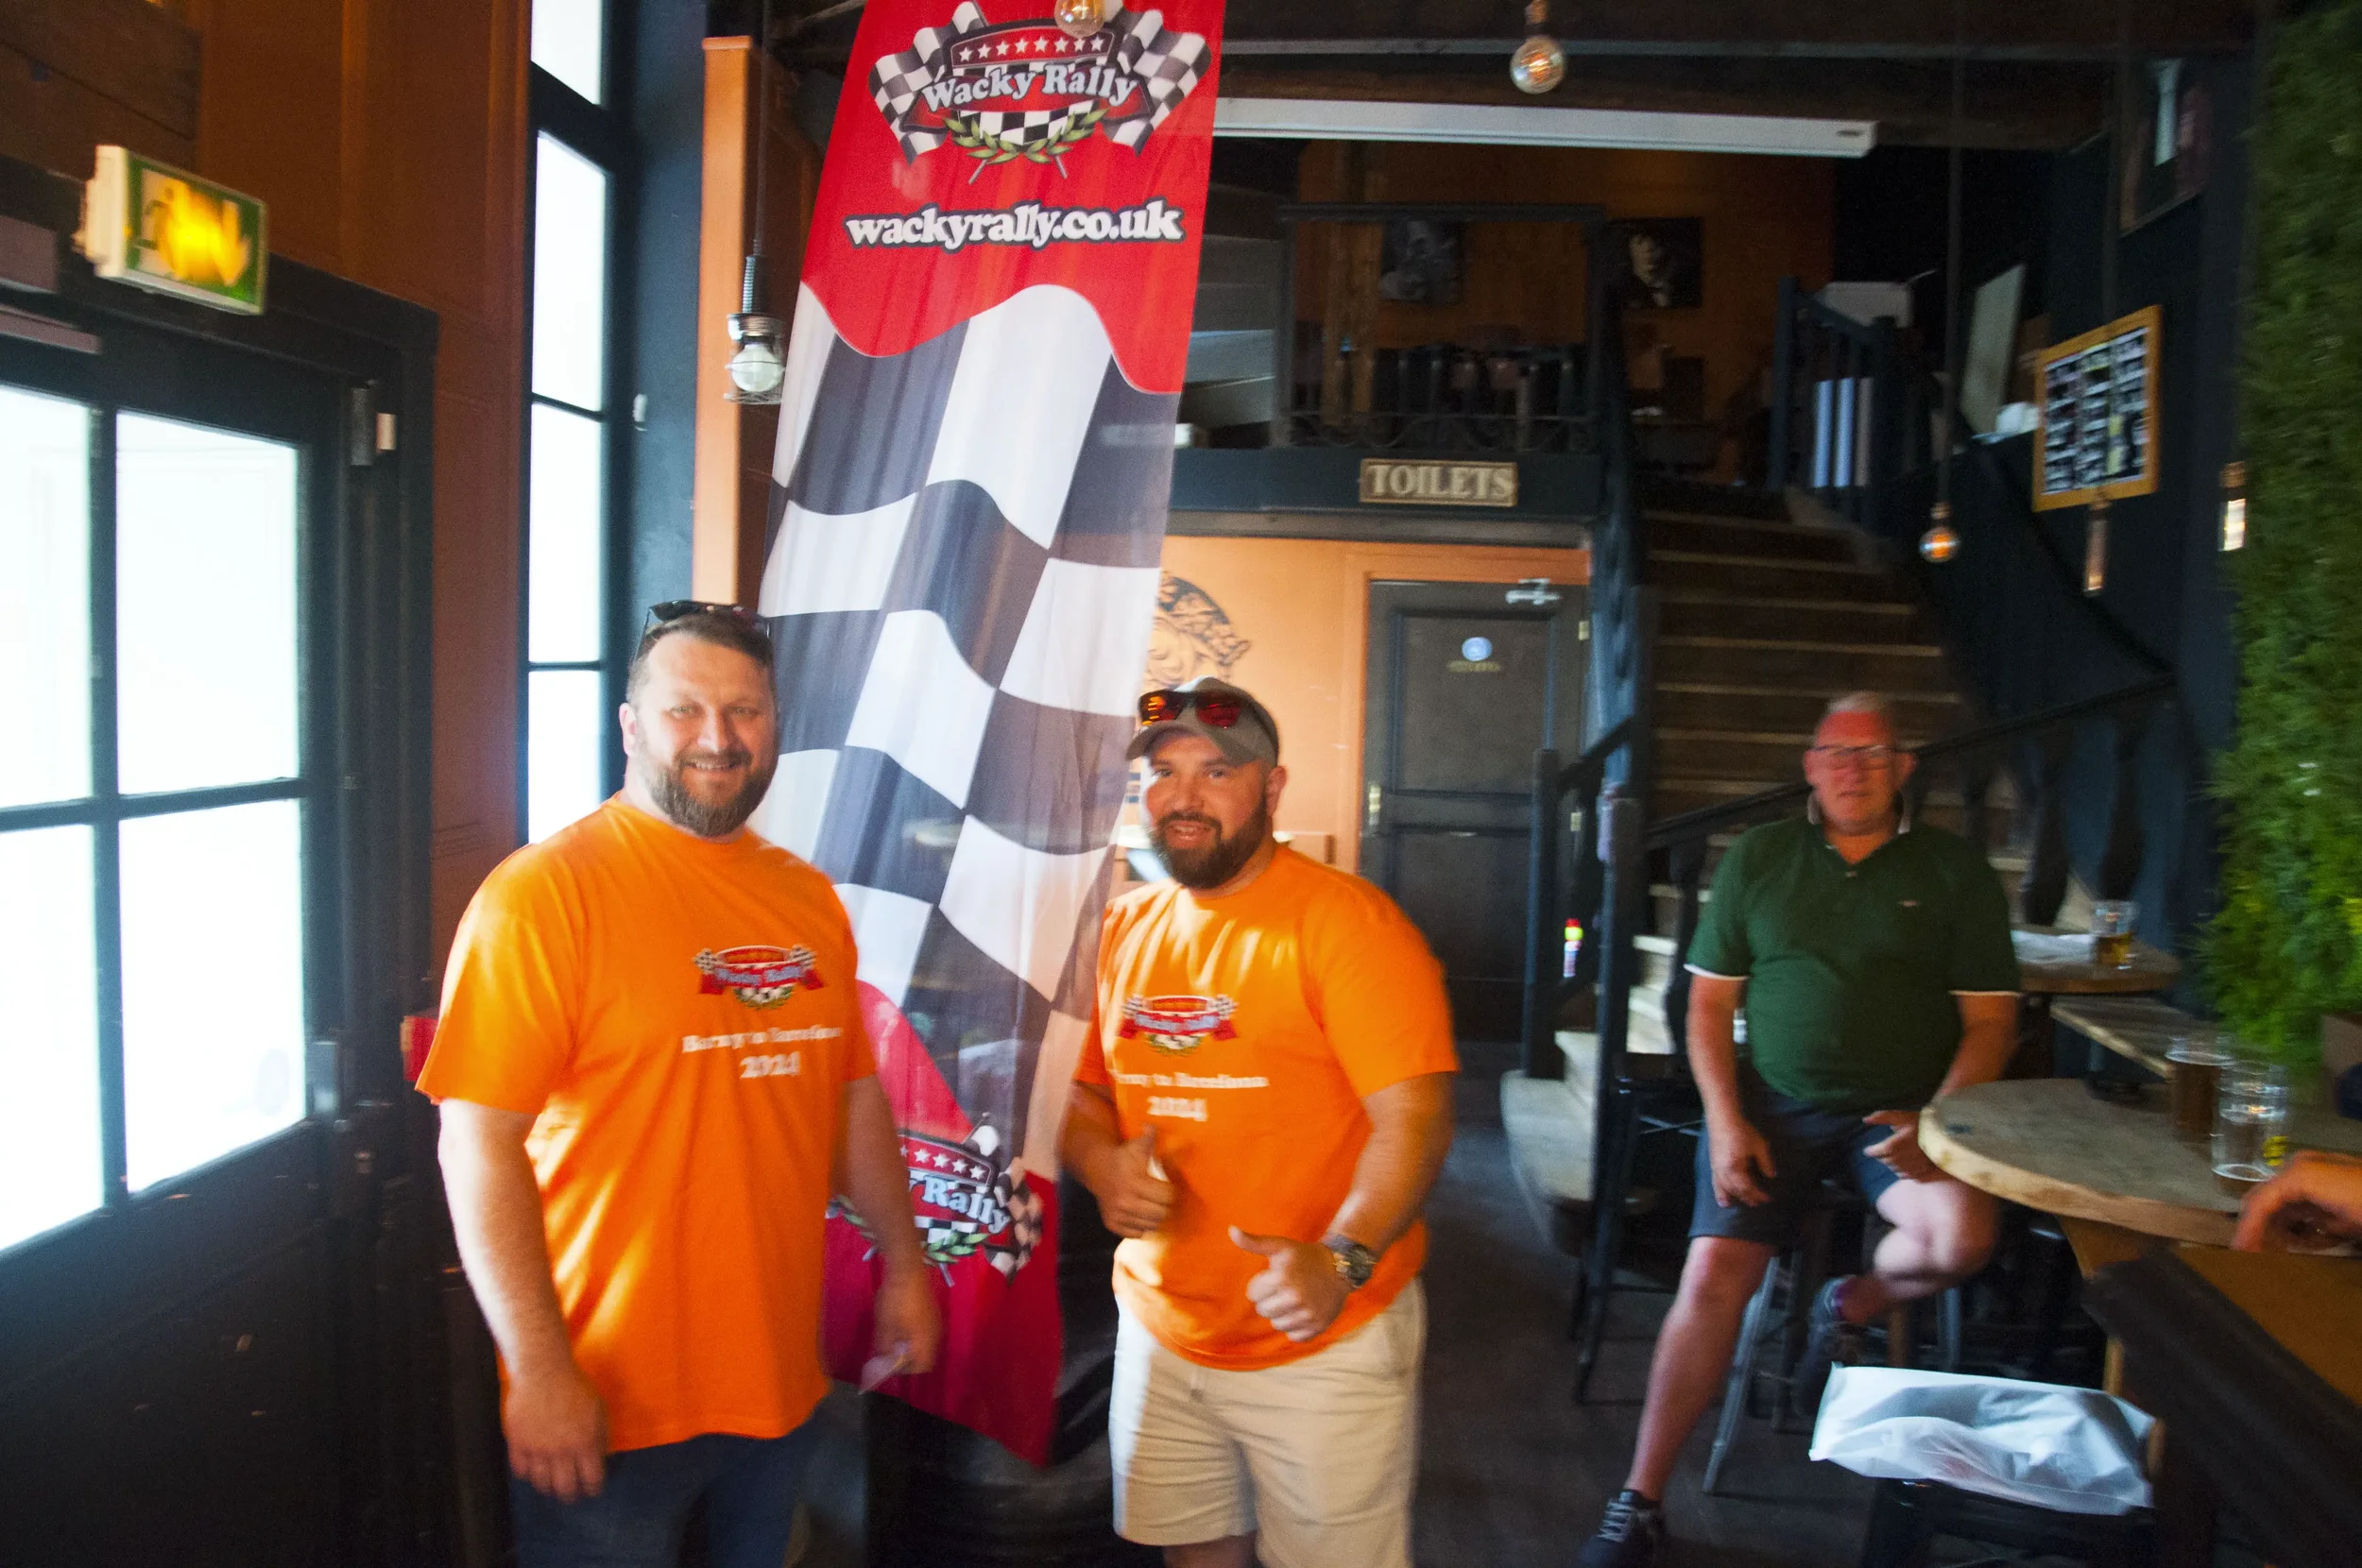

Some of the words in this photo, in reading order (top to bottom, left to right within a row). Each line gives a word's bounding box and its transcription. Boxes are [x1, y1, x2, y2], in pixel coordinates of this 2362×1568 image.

[922, 64, 1039, 111] Wacky
[1043, 64, 1138, 106] Rally
[846, 199, 1183, 248] wackyrally.co.uk
[1369, 464, 1515, 499] TOILETS
[921, 1175, 1011, 1234] Rally
